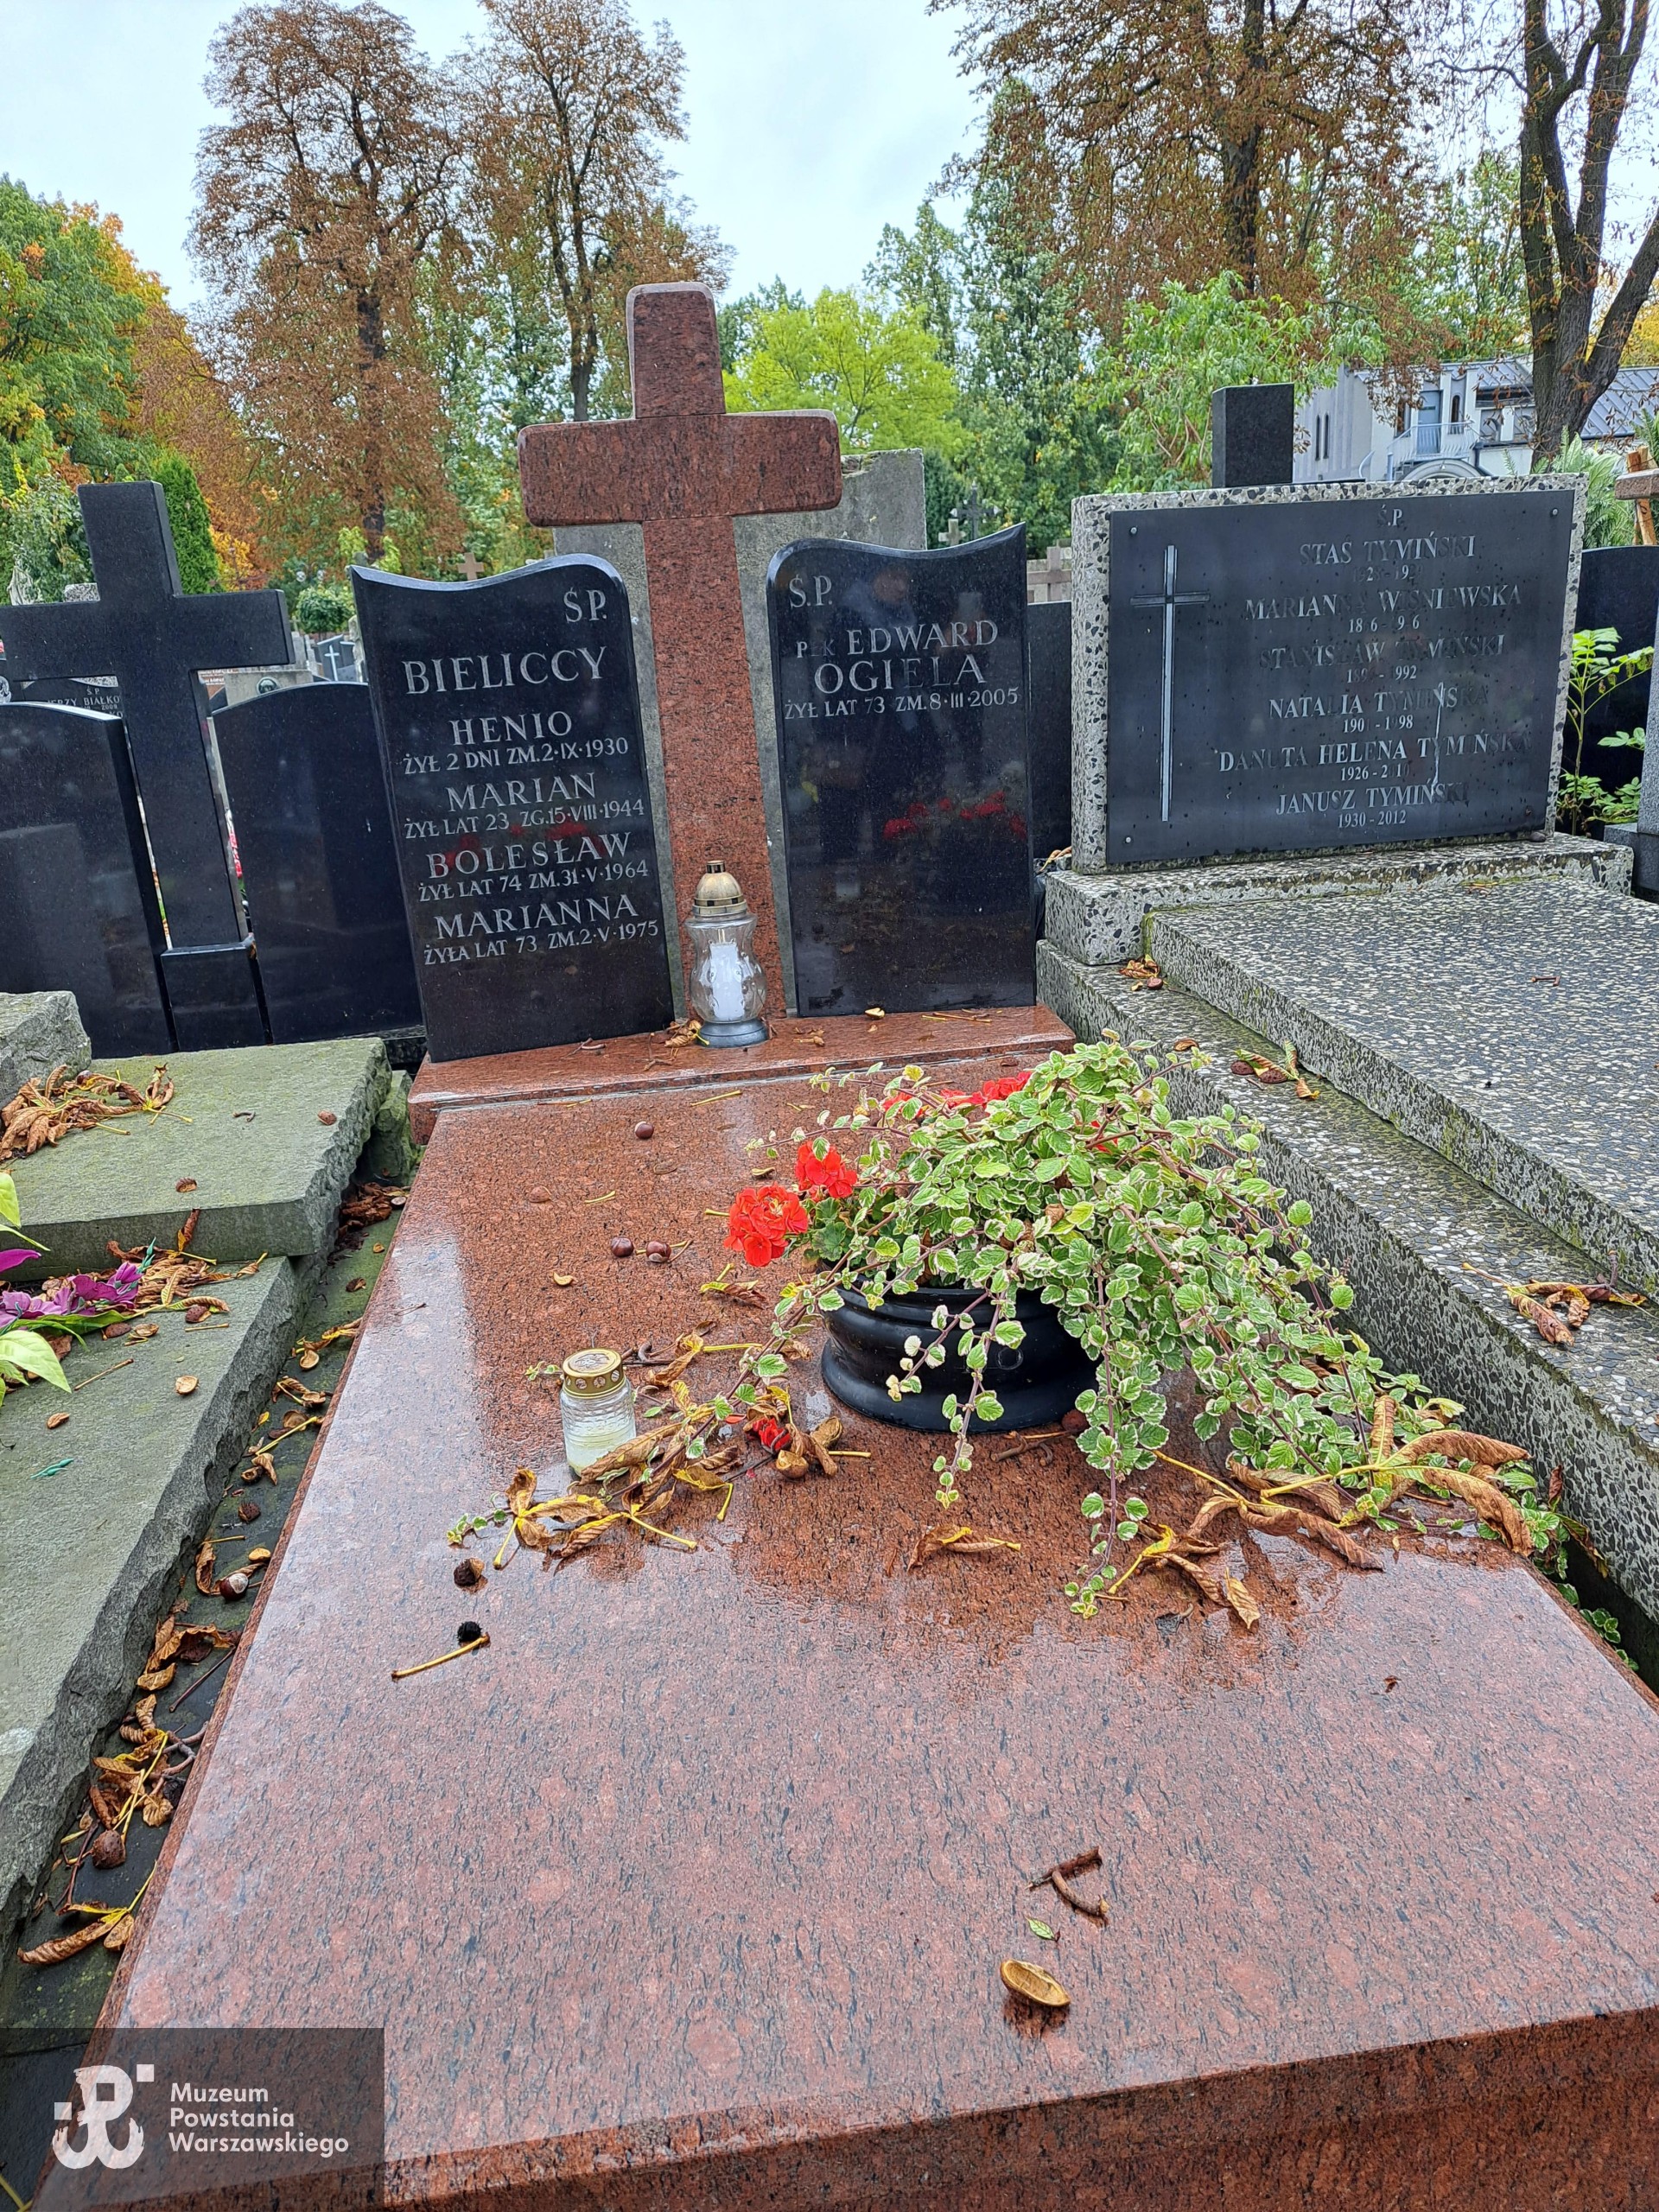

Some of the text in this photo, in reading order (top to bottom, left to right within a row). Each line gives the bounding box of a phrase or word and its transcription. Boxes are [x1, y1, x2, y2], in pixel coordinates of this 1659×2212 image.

[847, 620, 999, 655] EDWARD
[402, 645, 607, 695] BIELICCY
[814, 654, 987, 694] OGIELA
[83, 695, 120, 706] BIAŁKO
[785, 700, 818, 720] ŻYŁ
[825, 700, 857, 717] LAT
[864, 697, 886, 714] 73
[1268, 695, 1363, 719] NATALIA
[448, 711, 572, 746] HENIO
[403, 753, 440, 774] ŻYŁ
[447, 753, 460, 771] 2
[465, 749, 500, 769] DNI
[1219, 747, 1308, 772] DANUTA
[1319, 740, 1407, 765] HELENA
[1341, 766, 1369, 781] 1926
[446, 772, 596, 812] MARIAN
[1275, 789, 1356, 815] JANUSZ
[404, 817, 440, 839] ŻYŁ
[443, 817, 479, 835] LAT
[486, 812, 510, 830] 23
[1338, 812, 1366, 828] 1930
[1377, 810, 1407, 825] 2012
[426, 832, 632, 879] BOLESŁAW
[419, 882, 454, 902] ŻYŁ
[457, 879, 494, 897] LAT
[499, 875, 522, 893] 74
[434, 893, 639, 940] MARIANNA
[424, 944, 470, 965] ŻYŁA
[476, 940, 508, 958] LAT
[516, 936, 537, 953] 73
